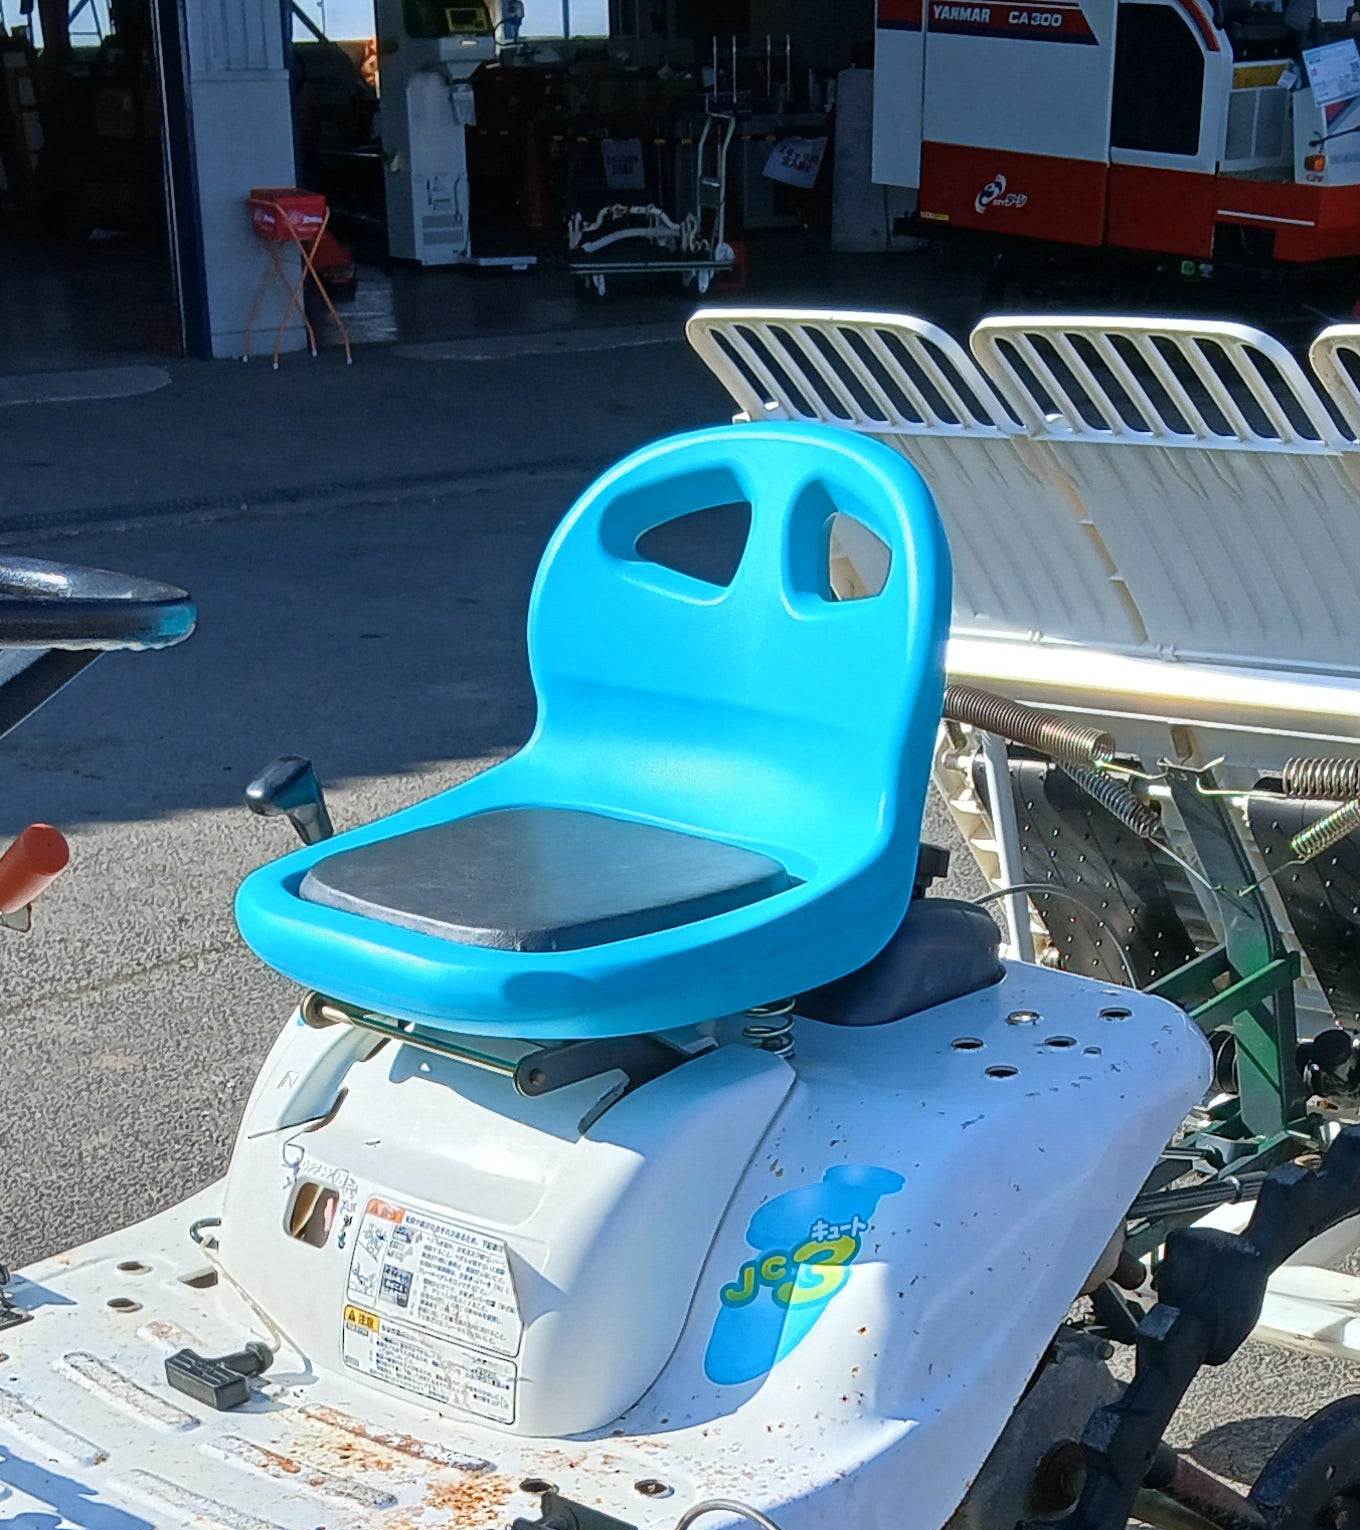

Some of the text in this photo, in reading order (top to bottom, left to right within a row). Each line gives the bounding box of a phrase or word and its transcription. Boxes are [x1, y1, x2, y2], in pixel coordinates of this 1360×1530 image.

[933, 4, 1063, 27] YANMAR CA300
[811, 1216, 867, 1242] キュート
